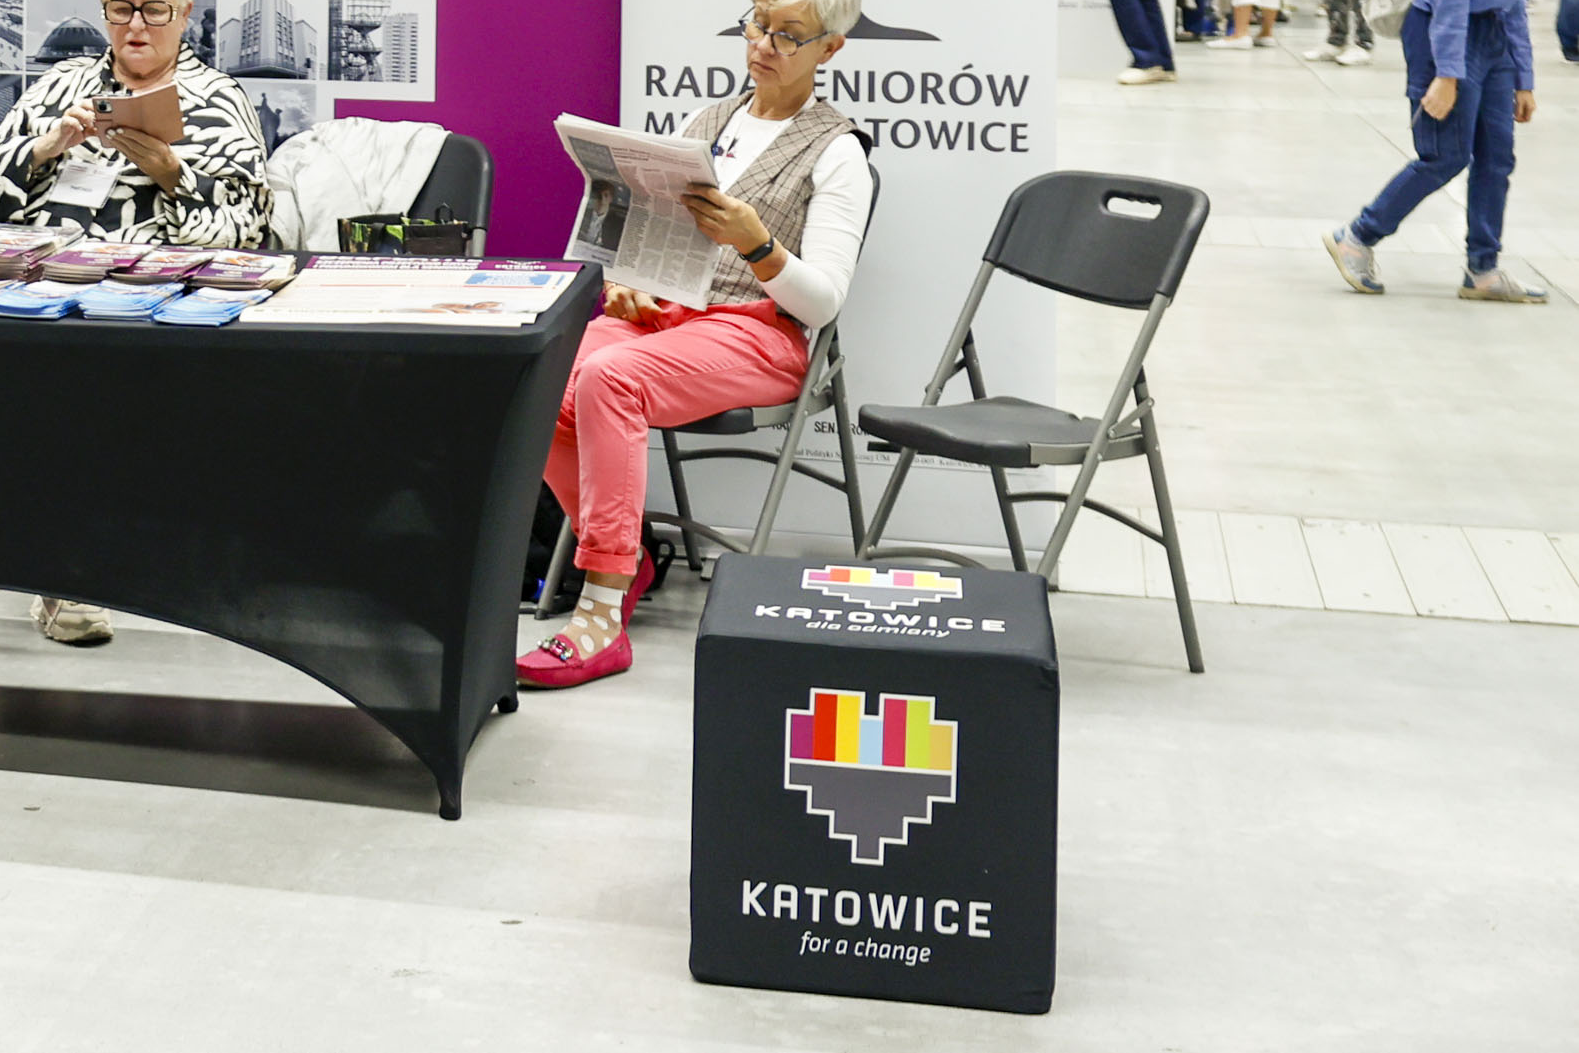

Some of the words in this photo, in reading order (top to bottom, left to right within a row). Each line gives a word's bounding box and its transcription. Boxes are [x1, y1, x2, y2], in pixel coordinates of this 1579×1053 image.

[754, 604, 1007, 633] KATOWICE
[806, 619, 839, 630] dla
[845, 623, 951, 638] odmiany
[741, 879, 993, 939] KATOWICE
[798, 932, 830, 957] for
[835, 940, 848, 955] a
[854, 936, 931, 966] change
